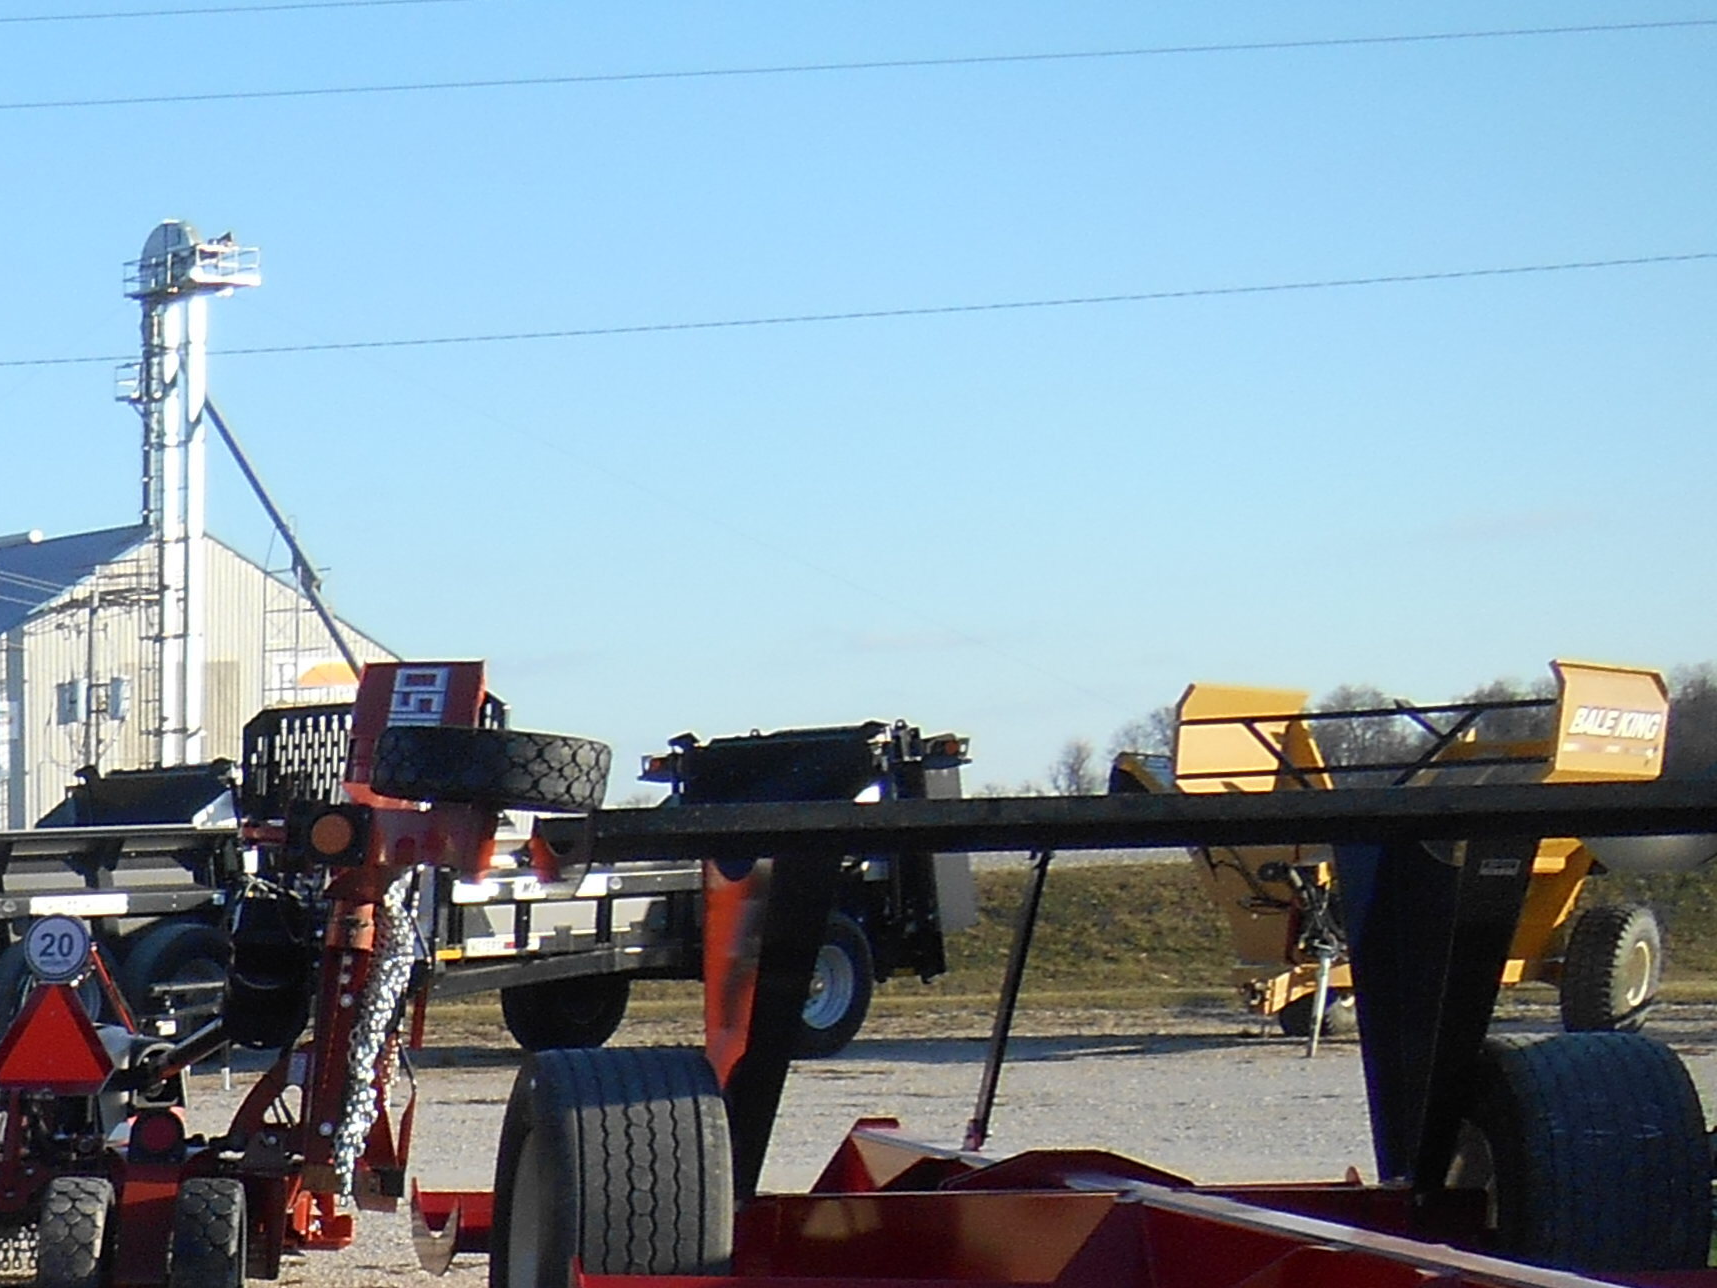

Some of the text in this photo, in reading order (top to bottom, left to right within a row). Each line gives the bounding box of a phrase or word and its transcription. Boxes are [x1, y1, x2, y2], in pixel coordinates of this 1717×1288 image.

[1568, 706, 1662, 740] BALE KING
[39, 932, 74, 958] 20
